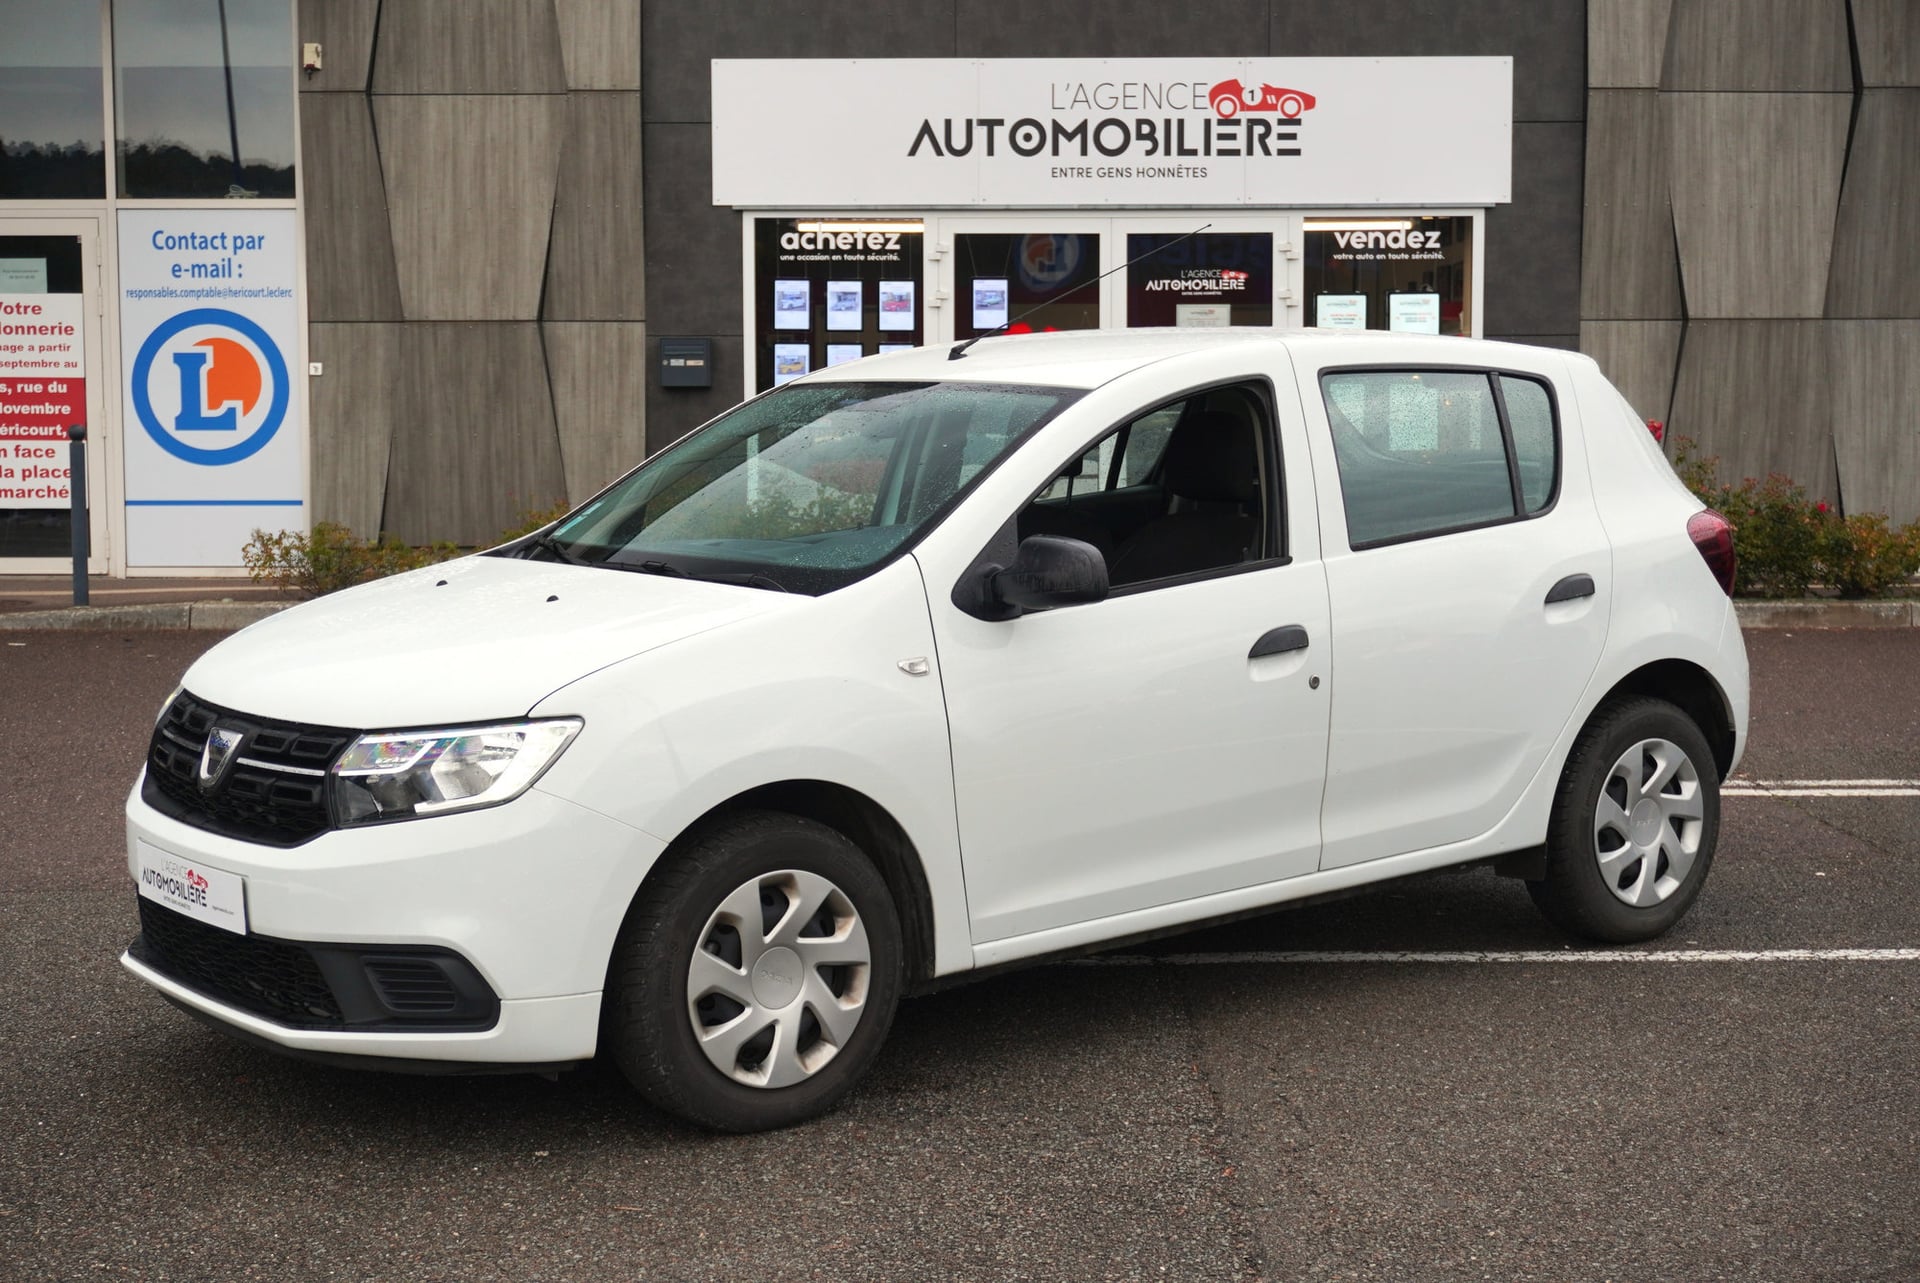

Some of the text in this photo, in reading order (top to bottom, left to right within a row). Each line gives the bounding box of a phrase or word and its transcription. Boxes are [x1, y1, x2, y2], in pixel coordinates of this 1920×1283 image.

[1051, 82, 1208, 110] L'AGENCE
[1247, 89, 1256, 102] 1
[1051, 163, 1208, 178] ENTRE GENS HONNÊTES
[780, 222, 901, 250] achetez
[1334, 221, 1441, 249] vendez
[152, 230, 264, 255] Contact par
[797, 252, 830, 261] occasion
[844, 253, 865, 261] toute
[1332, 252, 1354, 260] votre
[1355, 252, 1374, 260] auto
[1388, 252, 1409, 260] toute
[171, 257, 232, 278] e-mail
[1181, 270, 1221, 278] L'AGENCE
[0, 321, 75, 336] onnerie
[39, 342, 71, 353] partir
[64, 361, 78, 369] au
[16, 383, 43, 393] rue
[47, 381, 68, 393] du
[0, 402, 71, 415] ovembre
[14, 444, 56, 458] face
[22, 465, 72, 481] place
